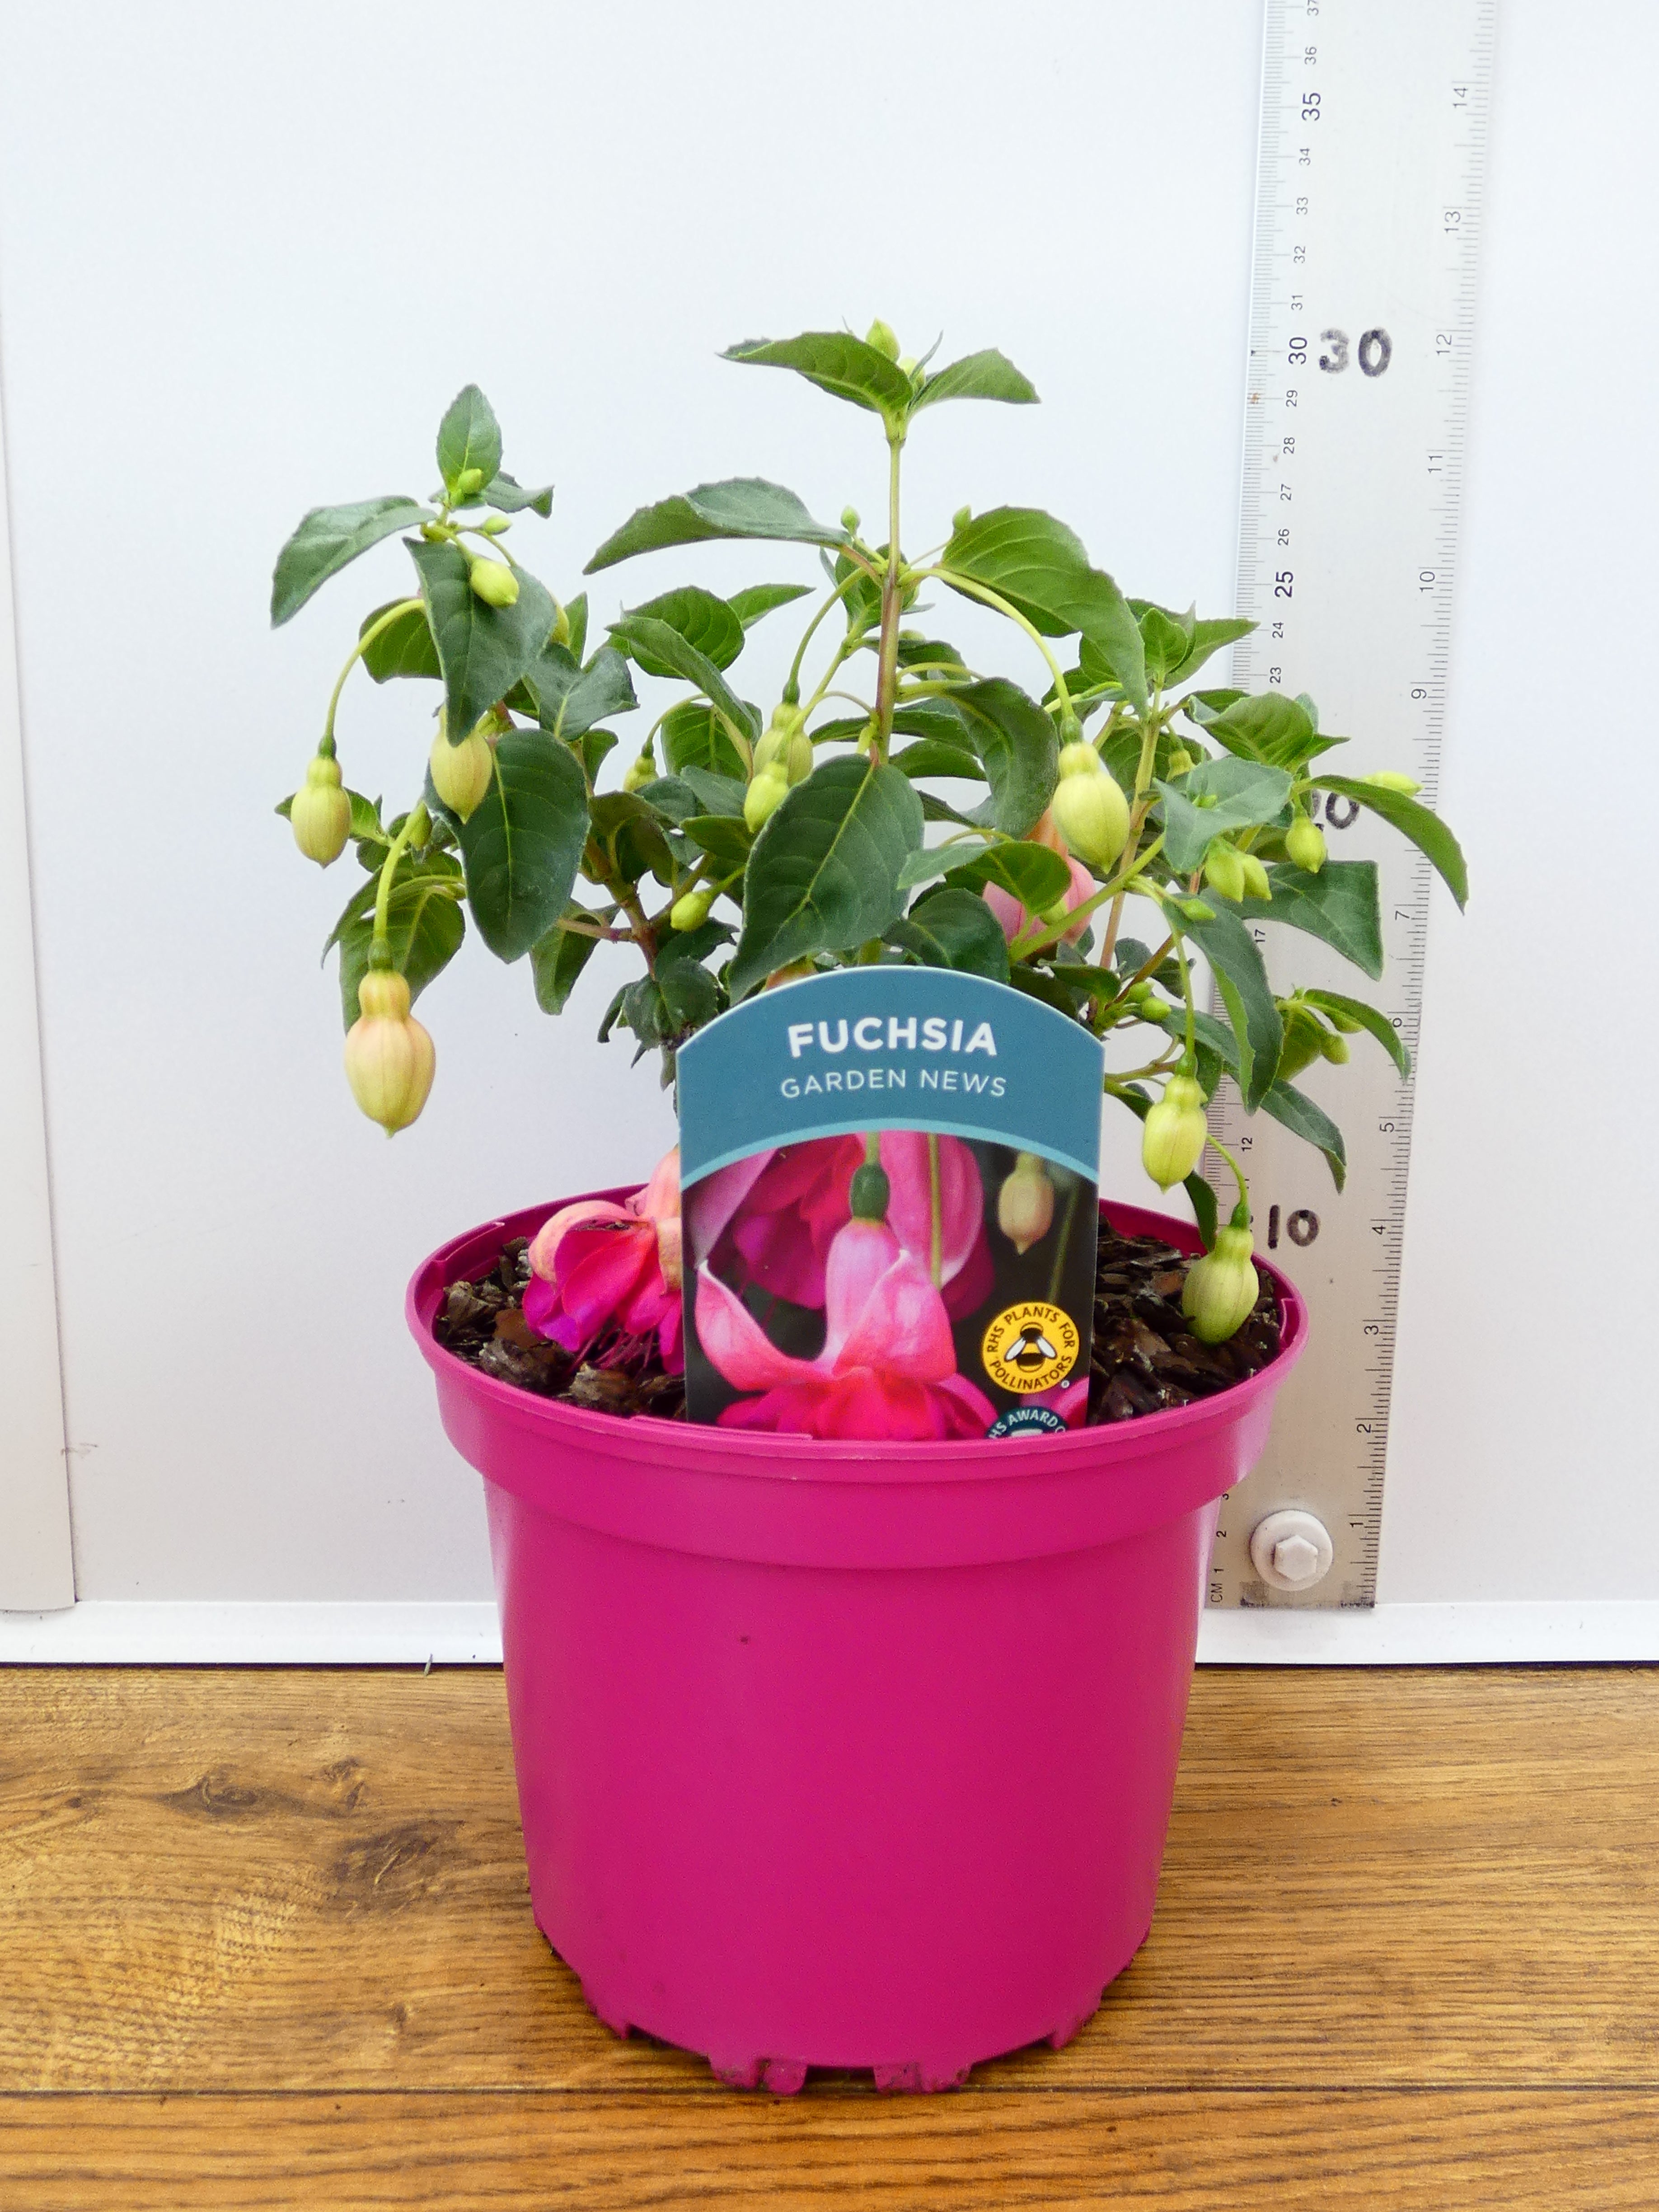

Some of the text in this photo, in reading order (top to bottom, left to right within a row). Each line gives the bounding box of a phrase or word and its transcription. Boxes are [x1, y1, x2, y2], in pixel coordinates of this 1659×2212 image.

[1304, 47, 1317, 65] 36
[1301, 93, 1321, 121] 35
[1453, 88, 1468, 108] 14
[1298, 148, 1311, 166] 34
[1296, 197, 1308, 215] 33
[1444, 211, 1461, 233] 13
[1293, 246, 1306, 263] 32
[1291, 295, 1303, 310] 31
[1288, 337, 1308, 365] 30
[1319, 327, 1392, 377] 30
[1436, 334, 1452, 356] 12
[1285, 390, 1298, 407] 29
[1283, 437, 1295, 454] 28
[1428, 455, 1443, 473] 11
[1280, 483, 1292, 501] 27
[1277, 529, 1290, 546] 26
[1274, 571, 1293, 598] 25
[1419, 571, 1435, 593] 10
[1272, 622, 1284, 638] 24
[1269, 667, 1281, 684] 23
[1411, 689, 1427, 699] 9
[1312, 789, 1360, 831] 0
[1395, 910, 1410, 920] 7
[1255, 928, 1265, 944] 17
[787, 1017, 997, 1058] FUCHSIA
[780, 1069, 1007, 1098] GARDEN NEWS
[1379, 1122, 1395, 1133] 5
[1241, 1137, 1253, 1152] 12
[1267, 1204, 1319, 1250] 10
[1372, 1225, 1386, 1235] 4
[987, 1306, 1075, 1352] RHS PLANTS FOR
[1364, 1325, 1379, 1335] 3
[989, 1355, 1072, 1390] POLLINATORS
[989, 1422, 1007, 1438] HS
[1008, 1409, 1058, 1427] AWARD
[1356, 1423, 1371, 1434] 2
[1210, 1583, 1223, 1603] CM
